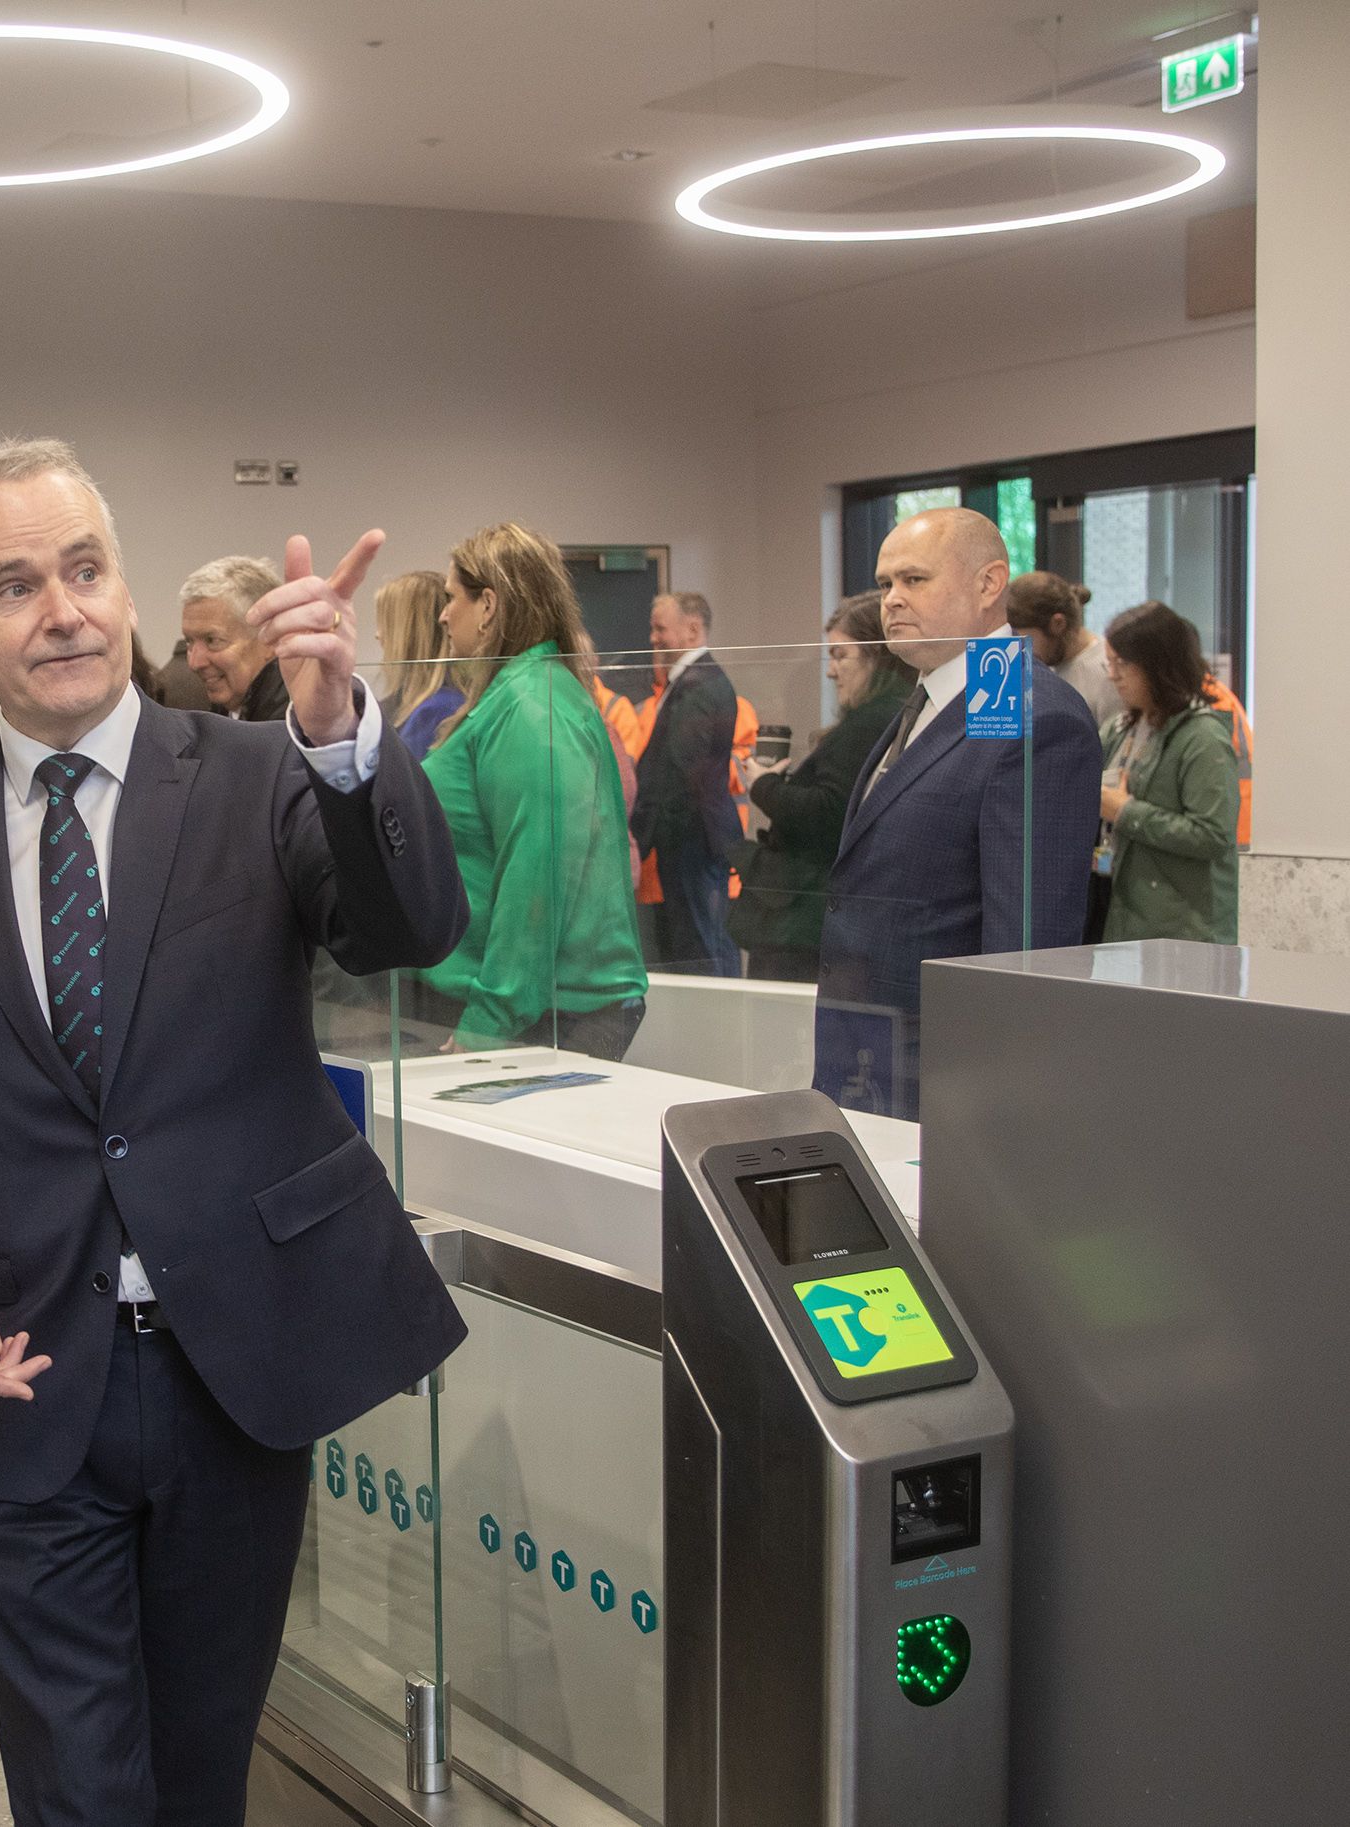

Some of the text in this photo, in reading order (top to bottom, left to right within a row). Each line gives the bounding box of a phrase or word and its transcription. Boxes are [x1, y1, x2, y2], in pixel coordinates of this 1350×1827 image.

[57, 850, 79, 876] Translink
[58, 891, 79, 917] Translink
[58, 930, 81, 957] Translink
[61, 970, 82, 997] Translink
[63, 1010, 84, 1037] Translink
[813, 1249, 849, 1260] FLOWBIRD
[813, 1304, 861, 1352] T
[894, 1565, 977, 1591] Place Barcode Here
